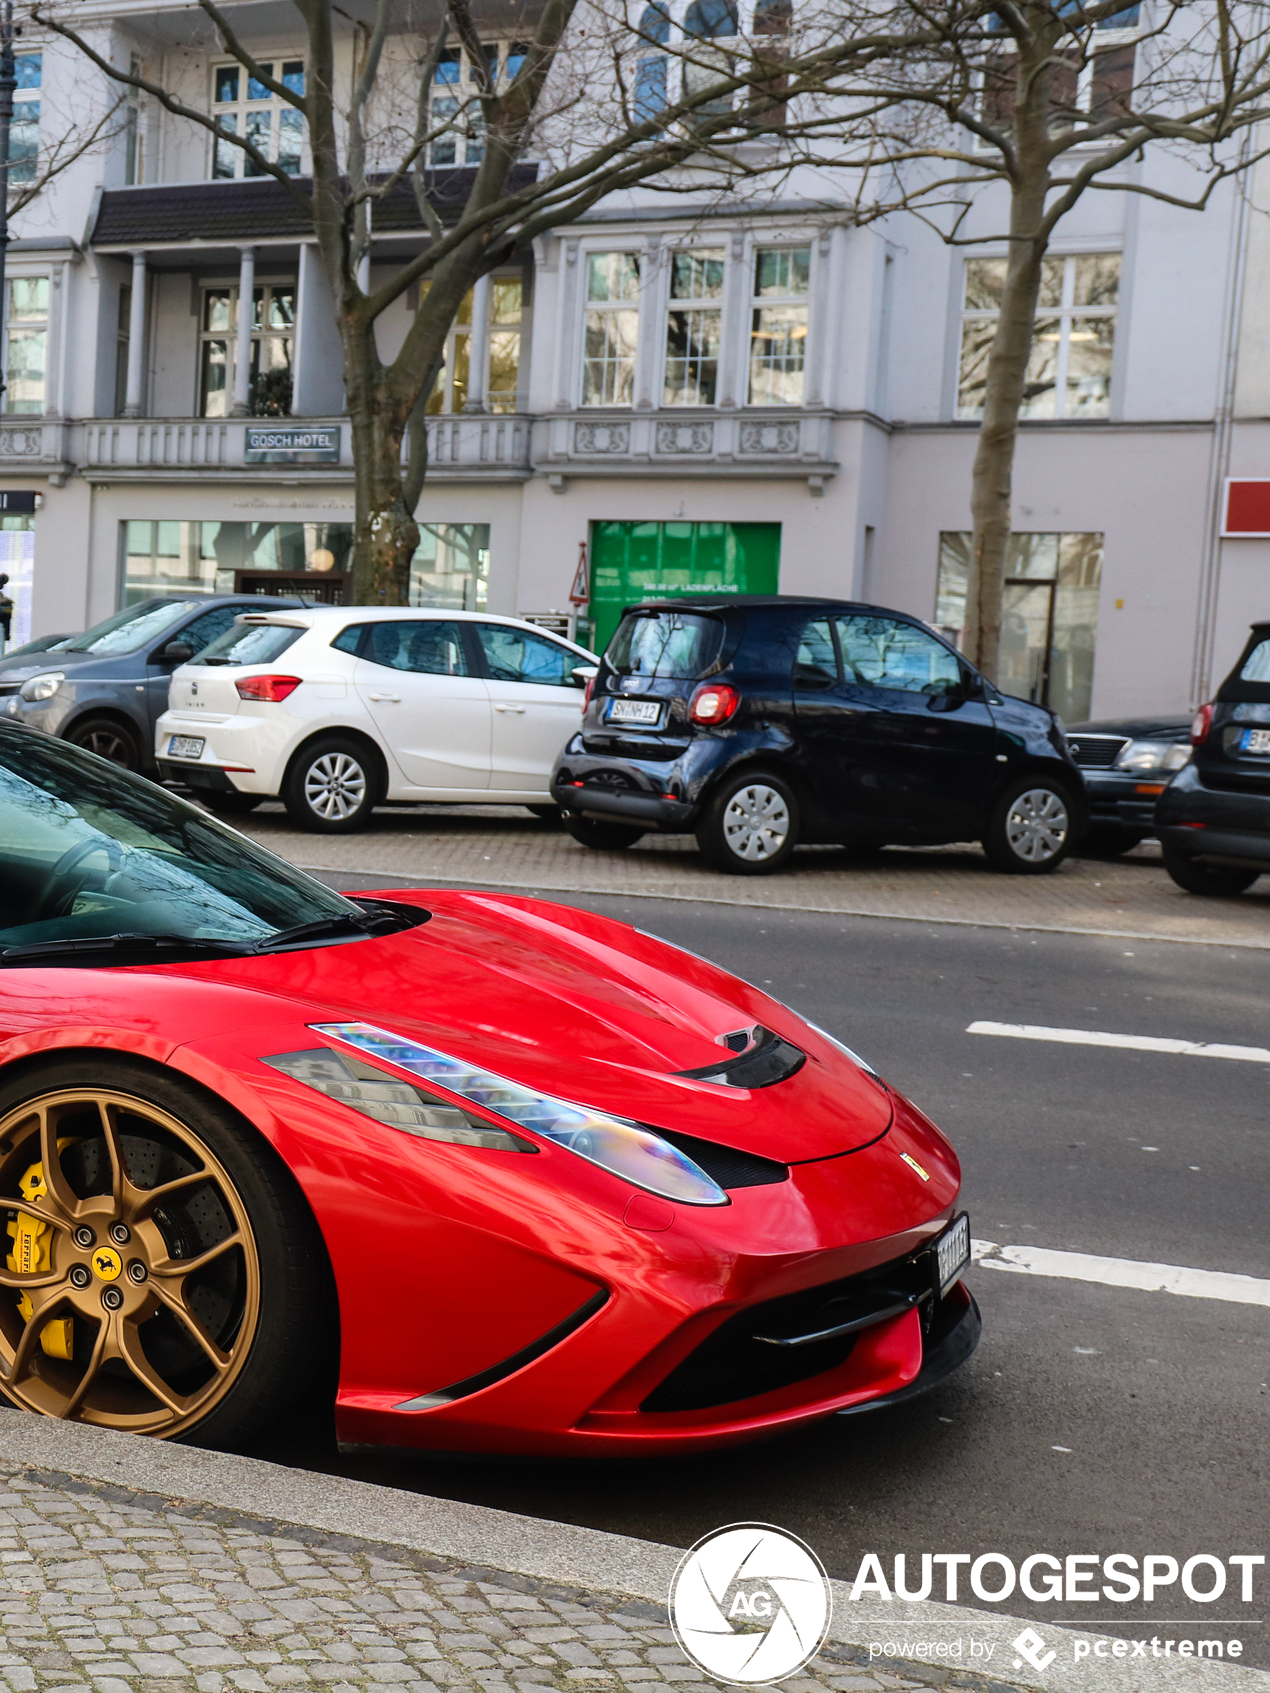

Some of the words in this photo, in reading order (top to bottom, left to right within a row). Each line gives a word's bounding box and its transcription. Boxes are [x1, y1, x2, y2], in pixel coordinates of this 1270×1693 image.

[251, 435, 291, 446] GOSCH
[294, 435, 332, 446] HOTEL
[23, 1233, 32, 1273] Ferrari
